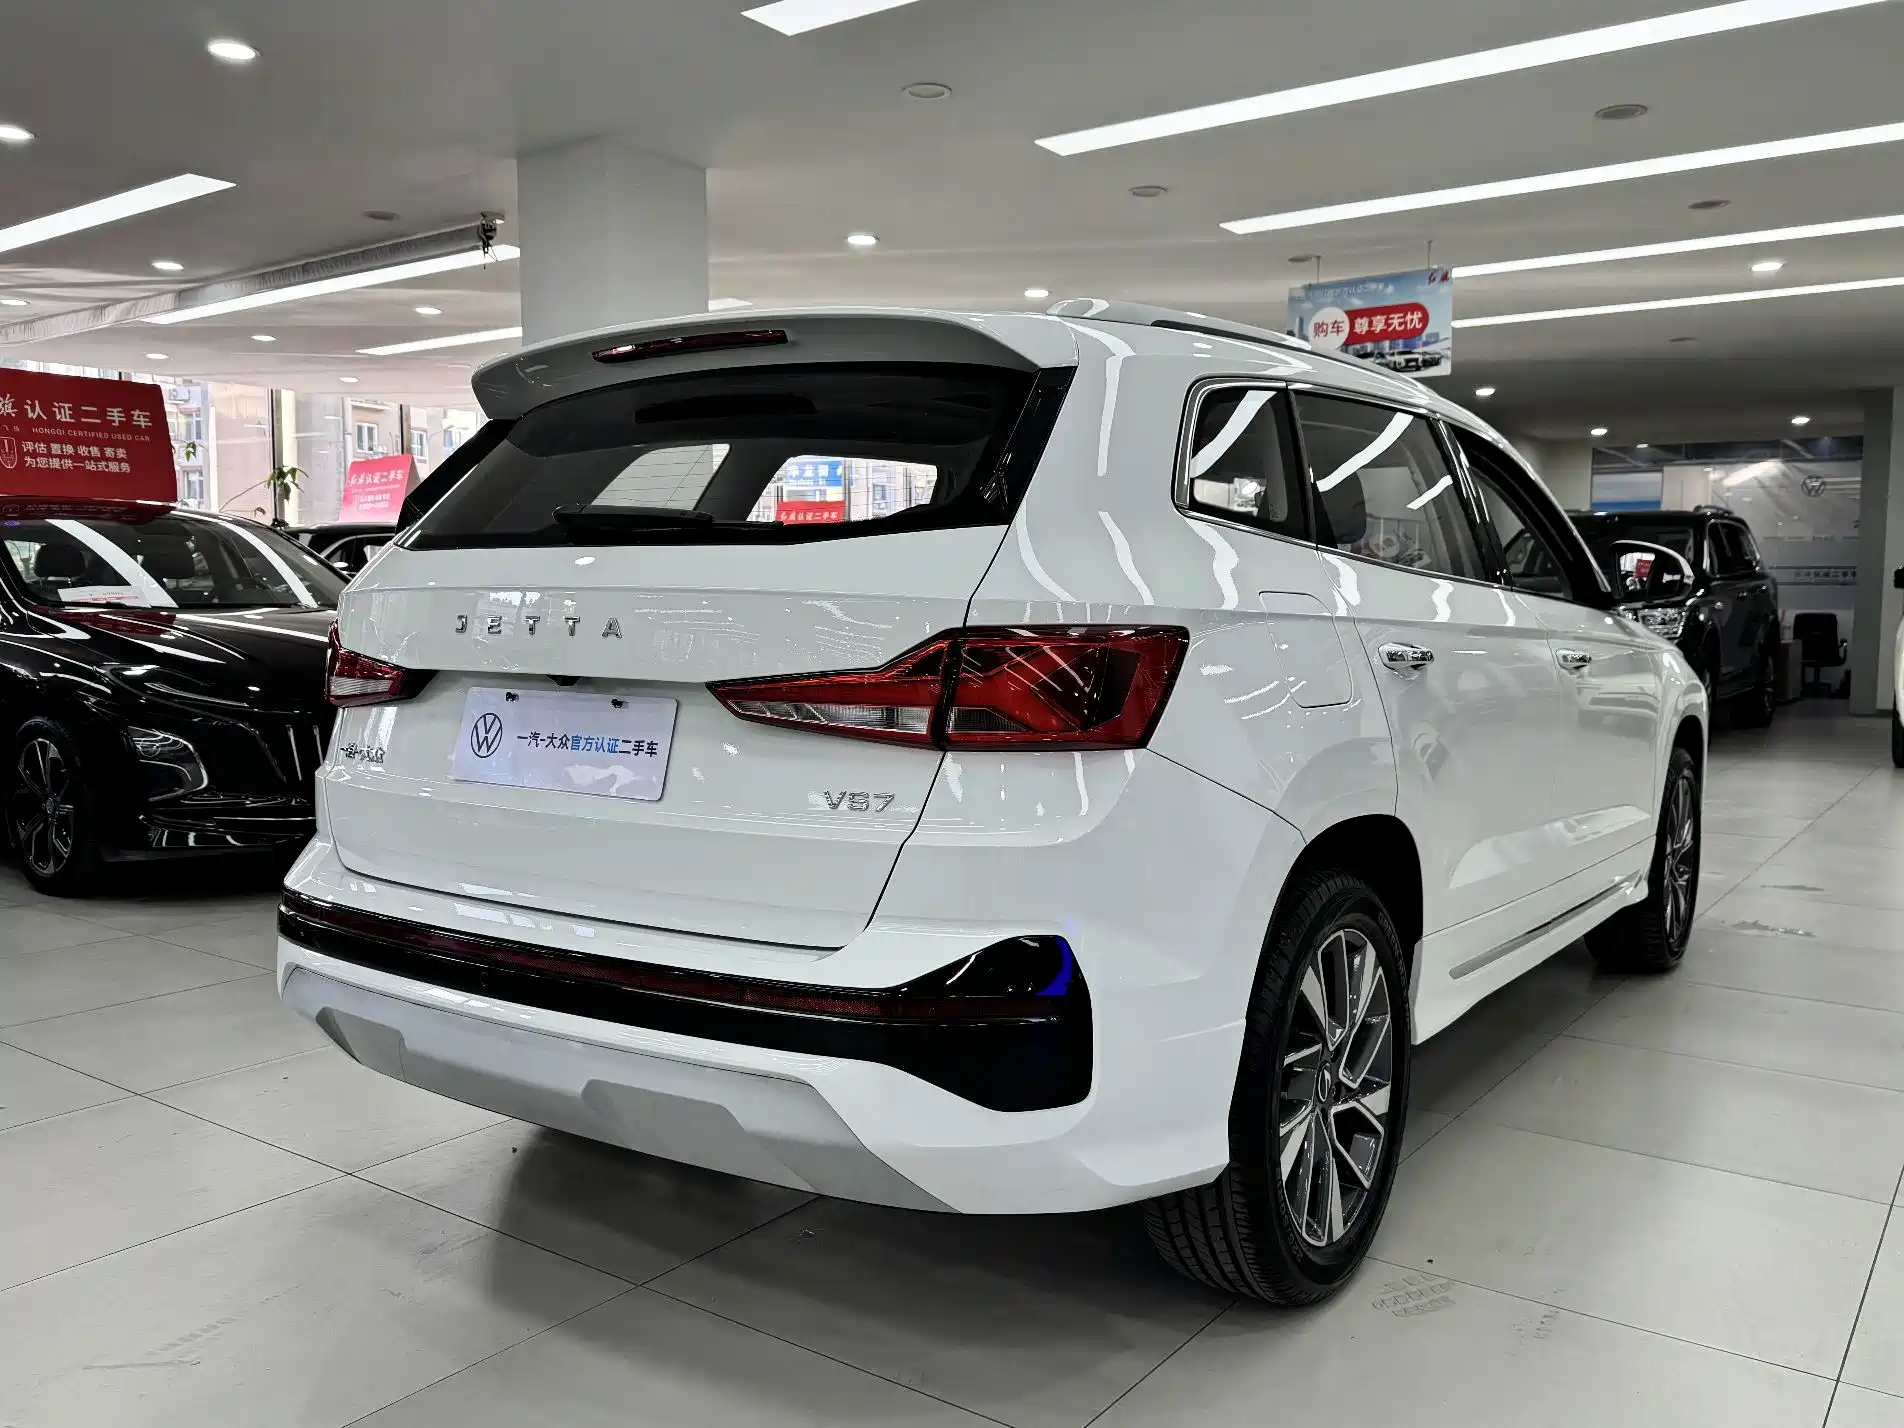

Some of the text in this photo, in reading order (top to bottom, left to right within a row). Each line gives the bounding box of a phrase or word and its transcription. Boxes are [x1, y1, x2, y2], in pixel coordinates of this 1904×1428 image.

[1313, 319, 1345, 338] 购车
[1353, 311, 1423, 335] 尊享无忧
[32, 427, 150, 442] HONGQI CERTIFIED USED CAR
[21, 440, 128, 460] 评估 置换 收售 寄卖
[24, 455, 131, 474] 为您提供一站式服务
[455, 614, 623, 639] JETTA
[823, 790, 895, 813] VS7
